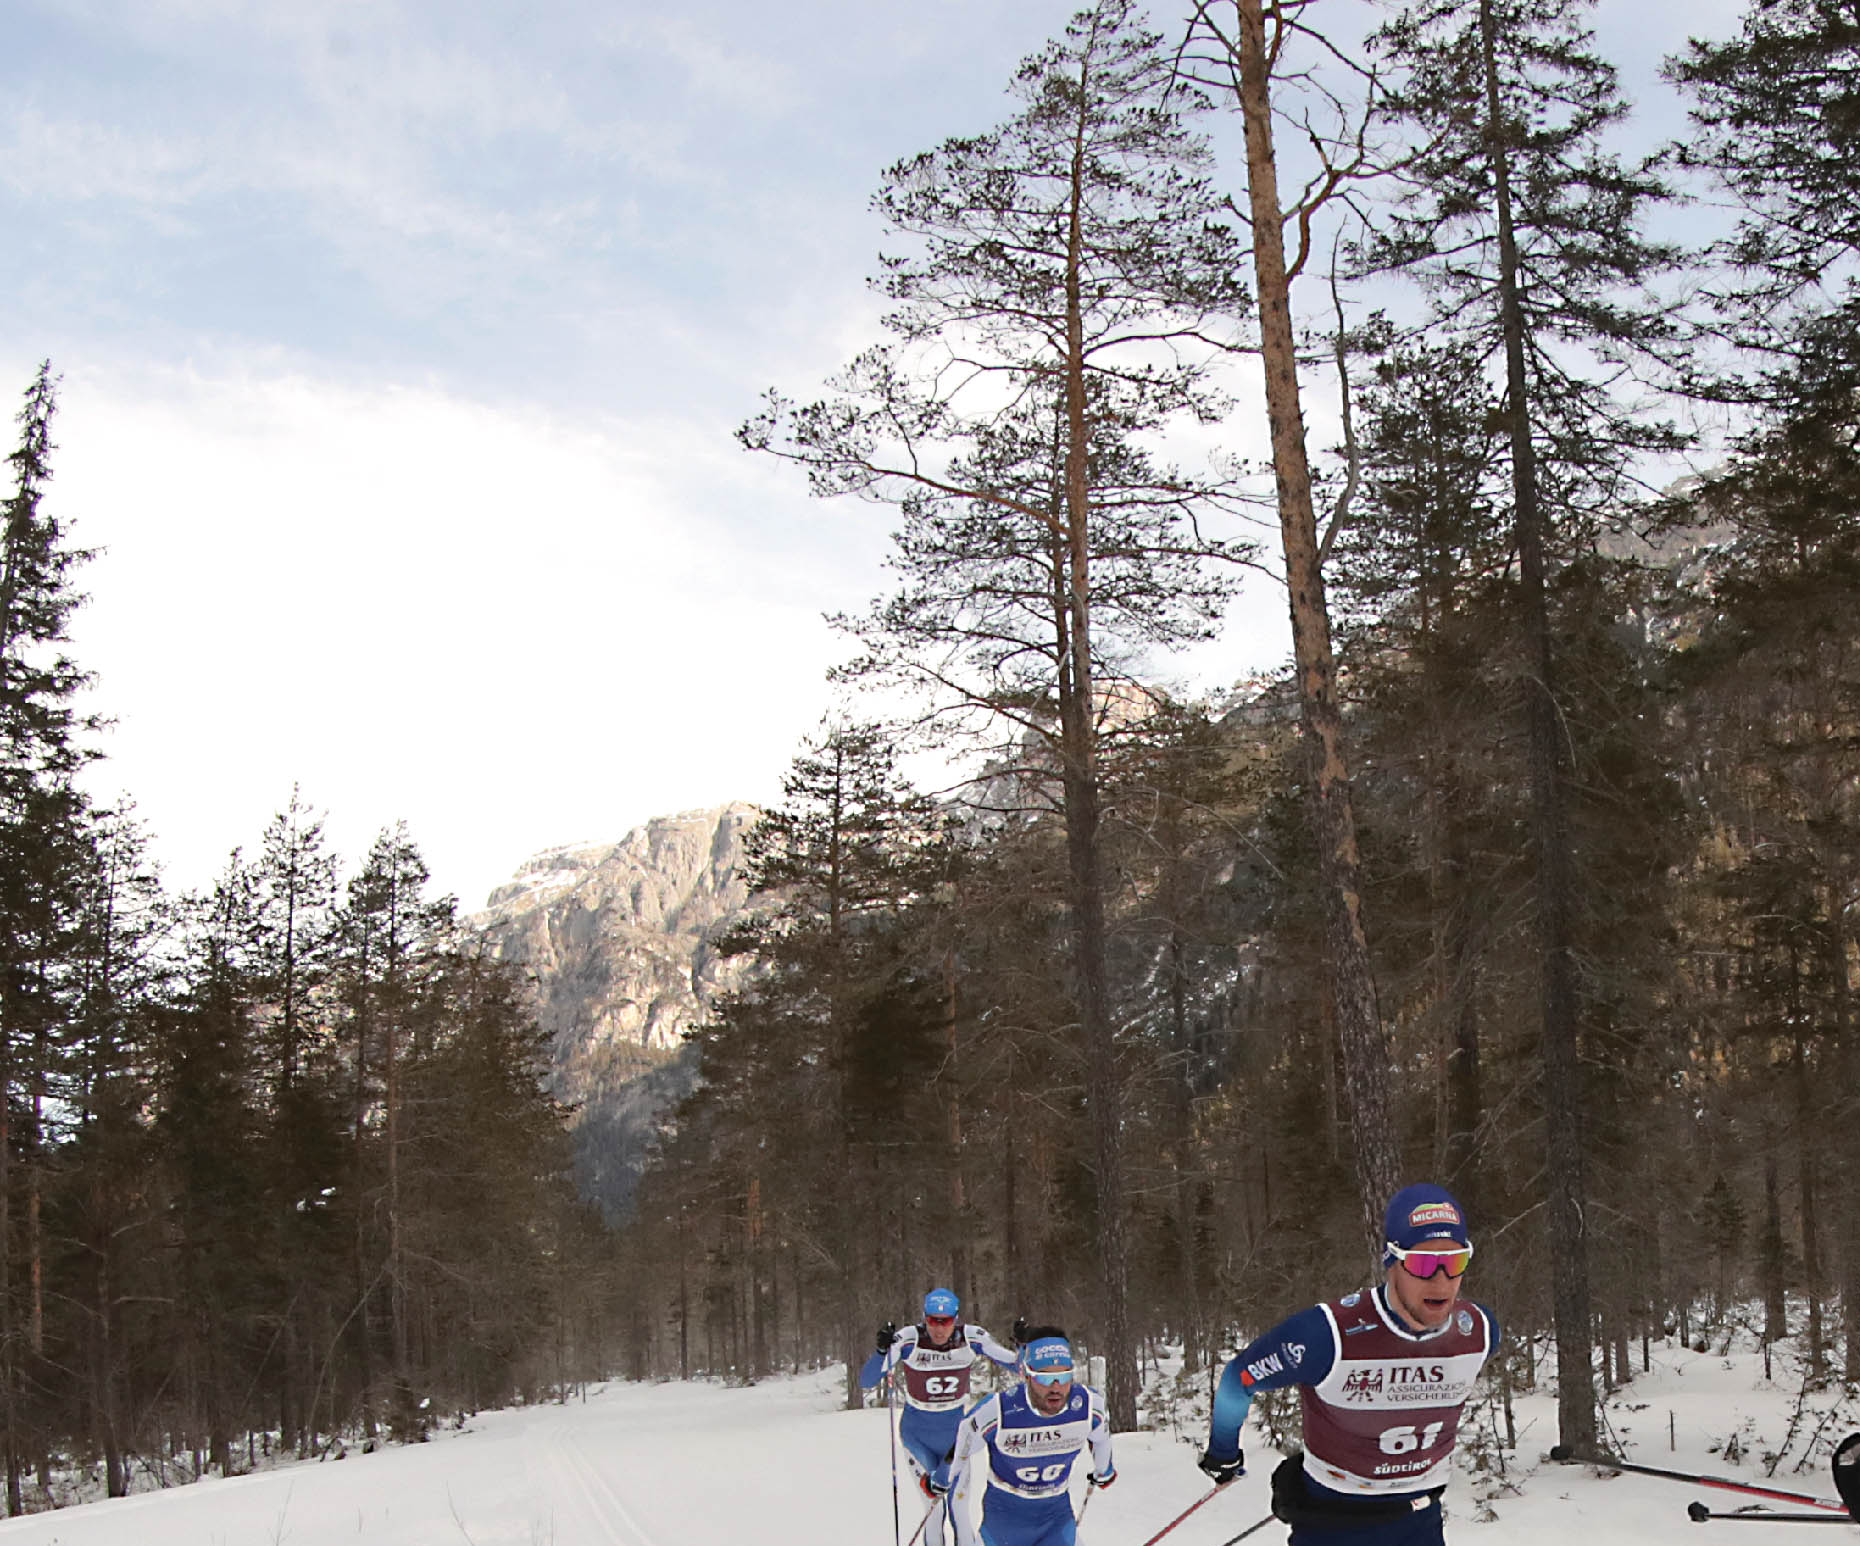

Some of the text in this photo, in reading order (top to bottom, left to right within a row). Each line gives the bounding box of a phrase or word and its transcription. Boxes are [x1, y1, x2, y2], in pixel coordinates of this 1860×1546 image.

[1412, 1210, 1457, 1223] MICARNA
[1247, 1352, 1284, 1381] BKW
[1388, 1365, 1445, 1384] ITAS
[926, 1376, 960, 1394] 62
[1030, 1429, 1062, 1442] ITAS
[1378, 1421, 1444, 1455] 61
[1015, 1463, 1067, 1483] 60
